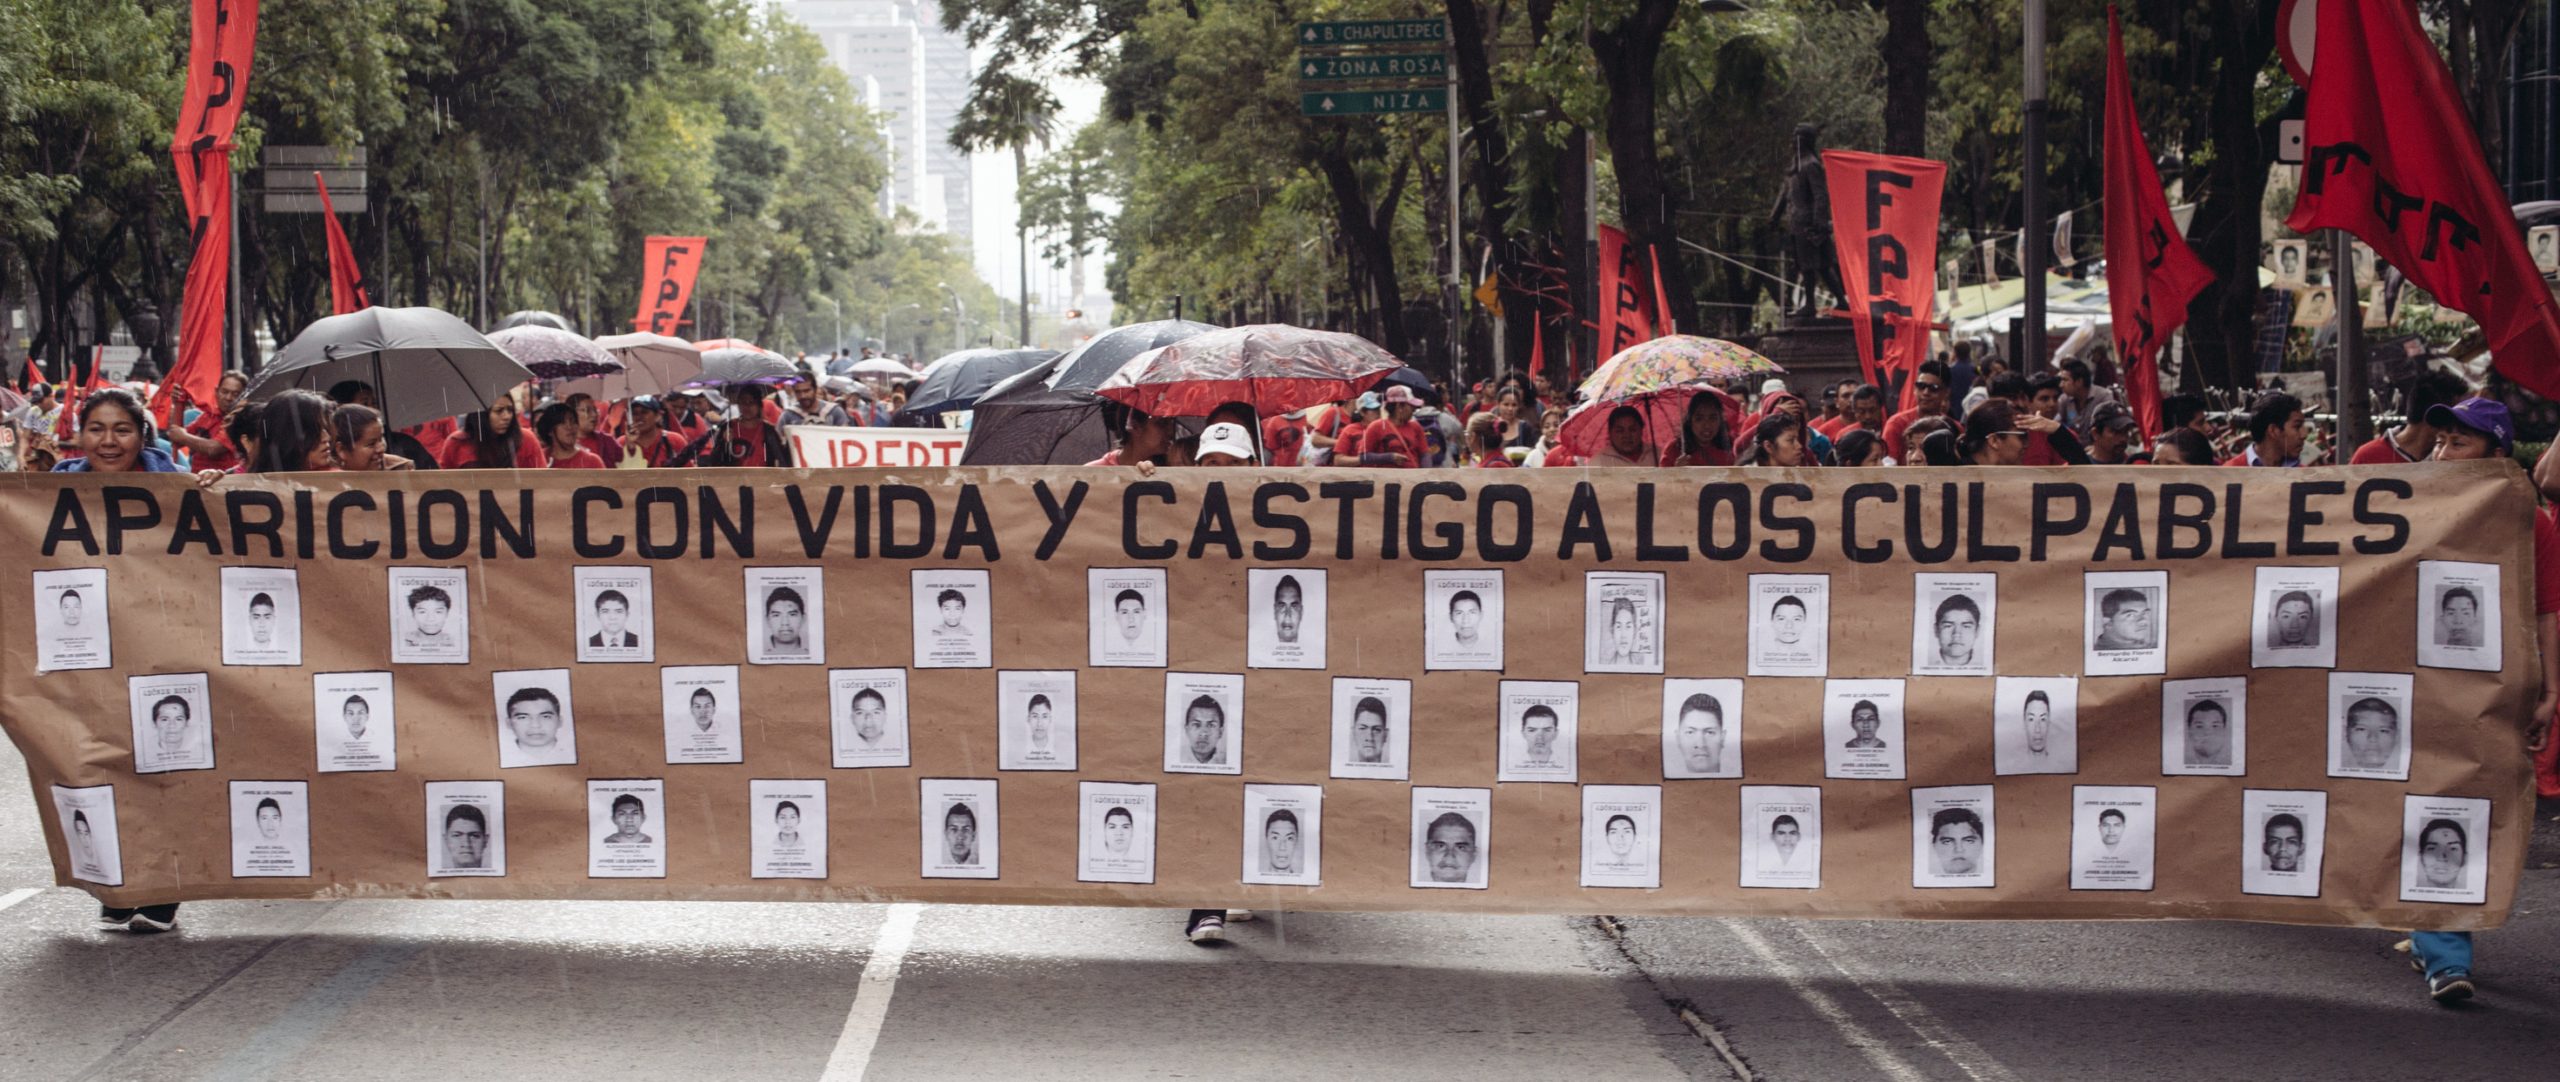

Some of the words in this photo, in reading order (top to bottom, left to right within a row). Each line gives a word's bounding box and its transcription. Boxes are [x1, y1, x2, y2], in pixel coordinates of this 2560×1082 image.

[1344, 24, 1442, 40] CHAPULTEPEC
[1327, 61, 1380, 75] ZONA
[1389, 58, 1442, 73] ROSA
[1373, 94, 1429, 109] NIZA
[42, 486, 535, 560] APARICION
[573, 486, 754, 559] CON
[785, 483, 1000, 562] VIDA
[1033, 480, 1088, 560] Y
[1123, 481, 1533, 562] CASTIGO
[1558, 482, 1612, 562] A
[1636, 482, 1815, 563] LOS
[1842, 479, 2412, 564] CULPABLES
